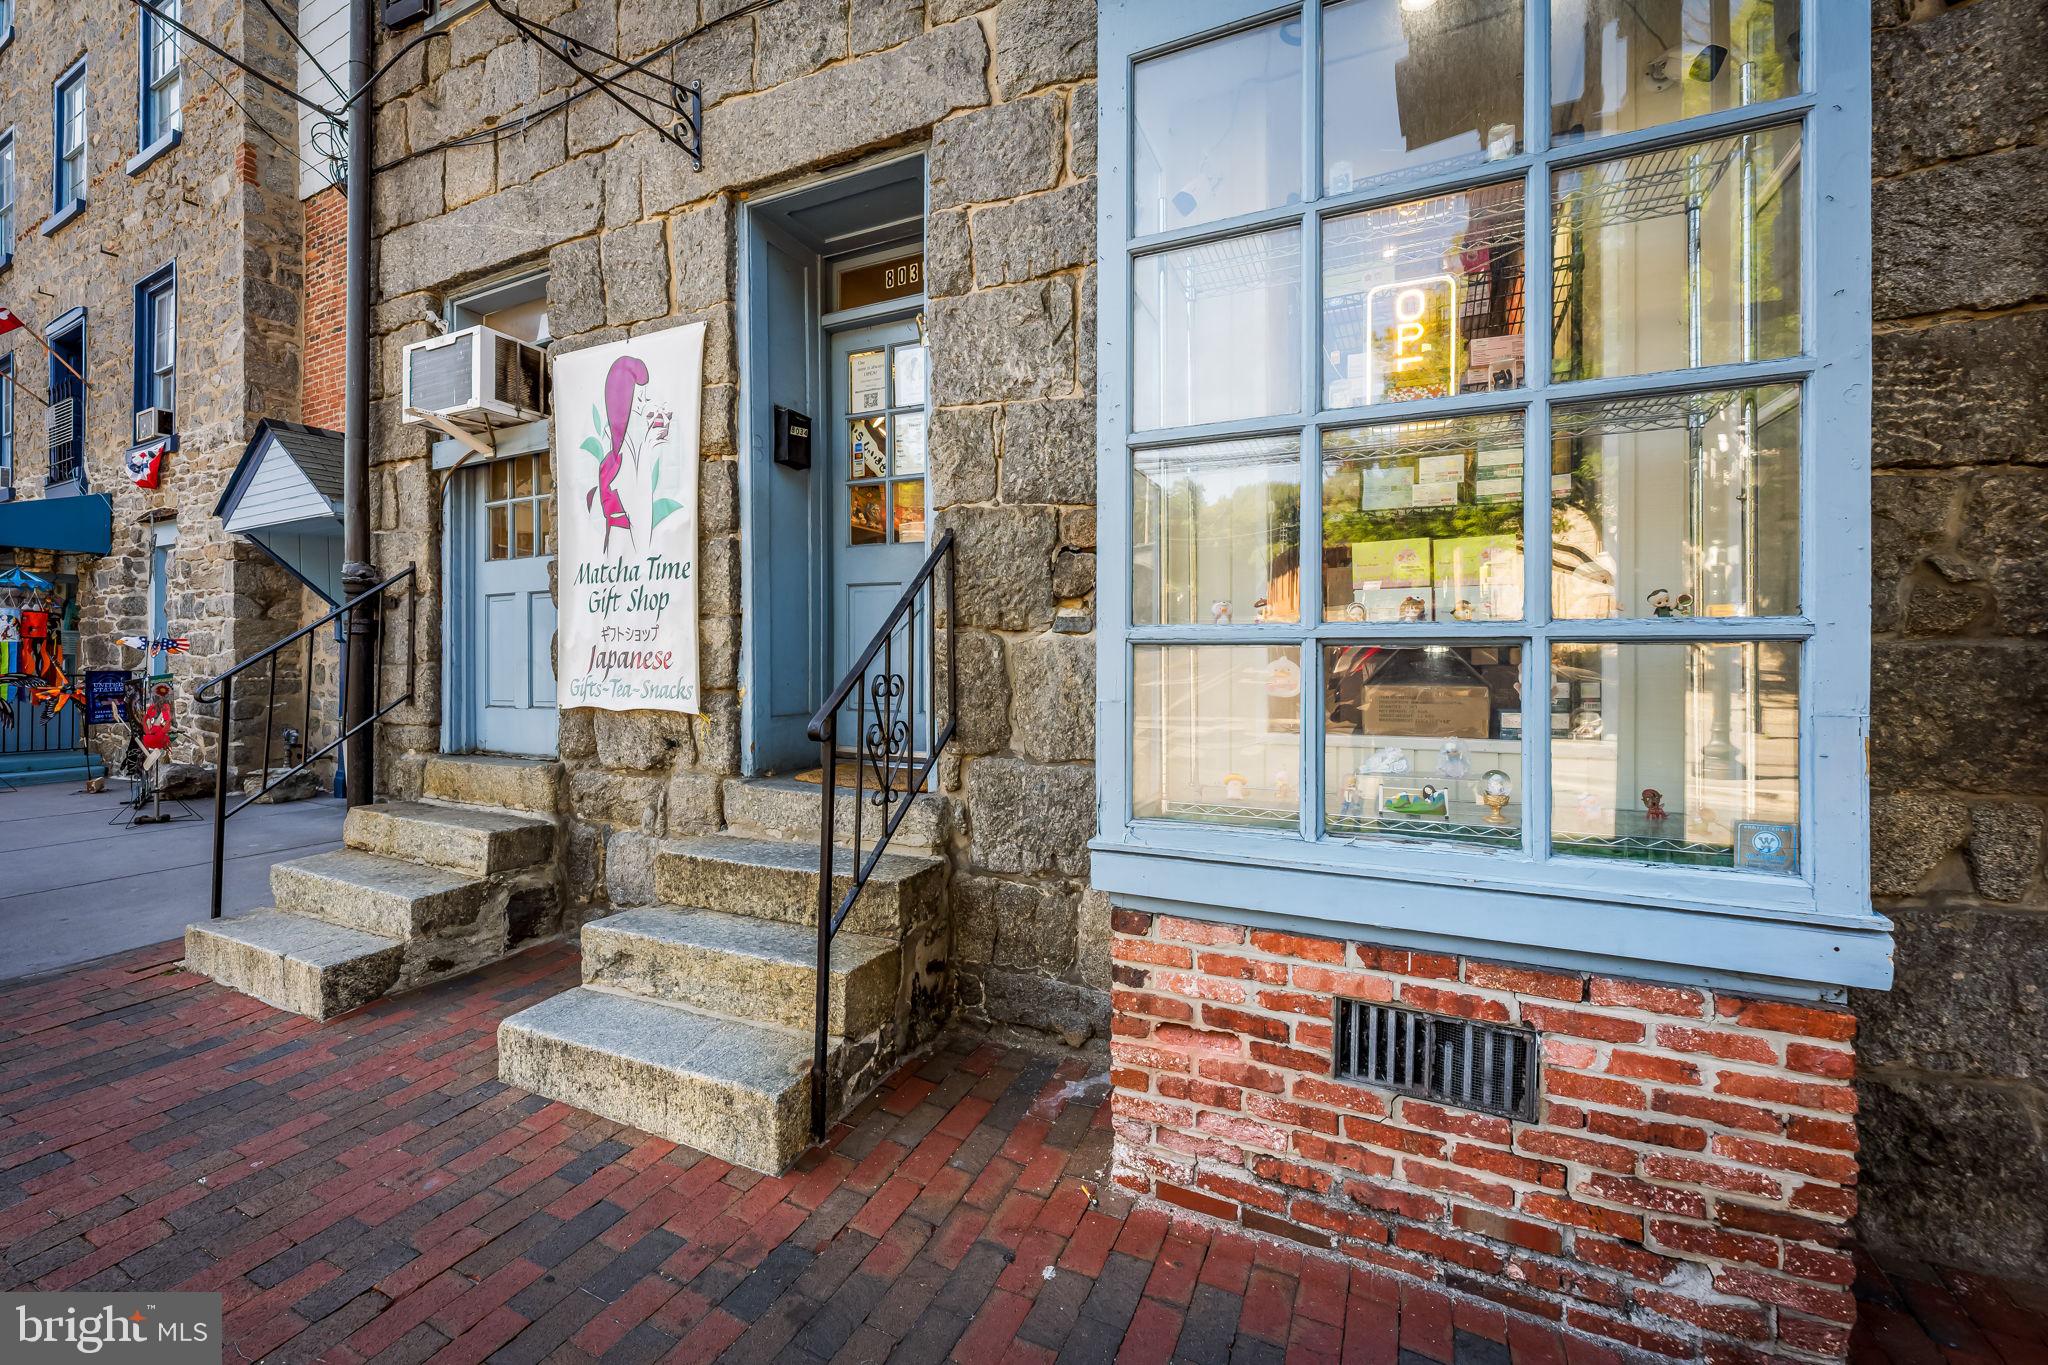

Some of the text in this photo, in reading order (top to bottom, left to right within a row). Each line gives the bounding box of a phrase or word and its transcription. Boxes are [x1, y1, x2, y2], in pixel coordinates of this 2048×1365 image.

[886, 263, 919, 288] 803
[573, 554, 691, 586] Matcha Time
[588, 584, 670, 622] Gift Shop
[601, 624, 660, 642] ギフトショップ
[586, 644, 674, 682] Japanese
